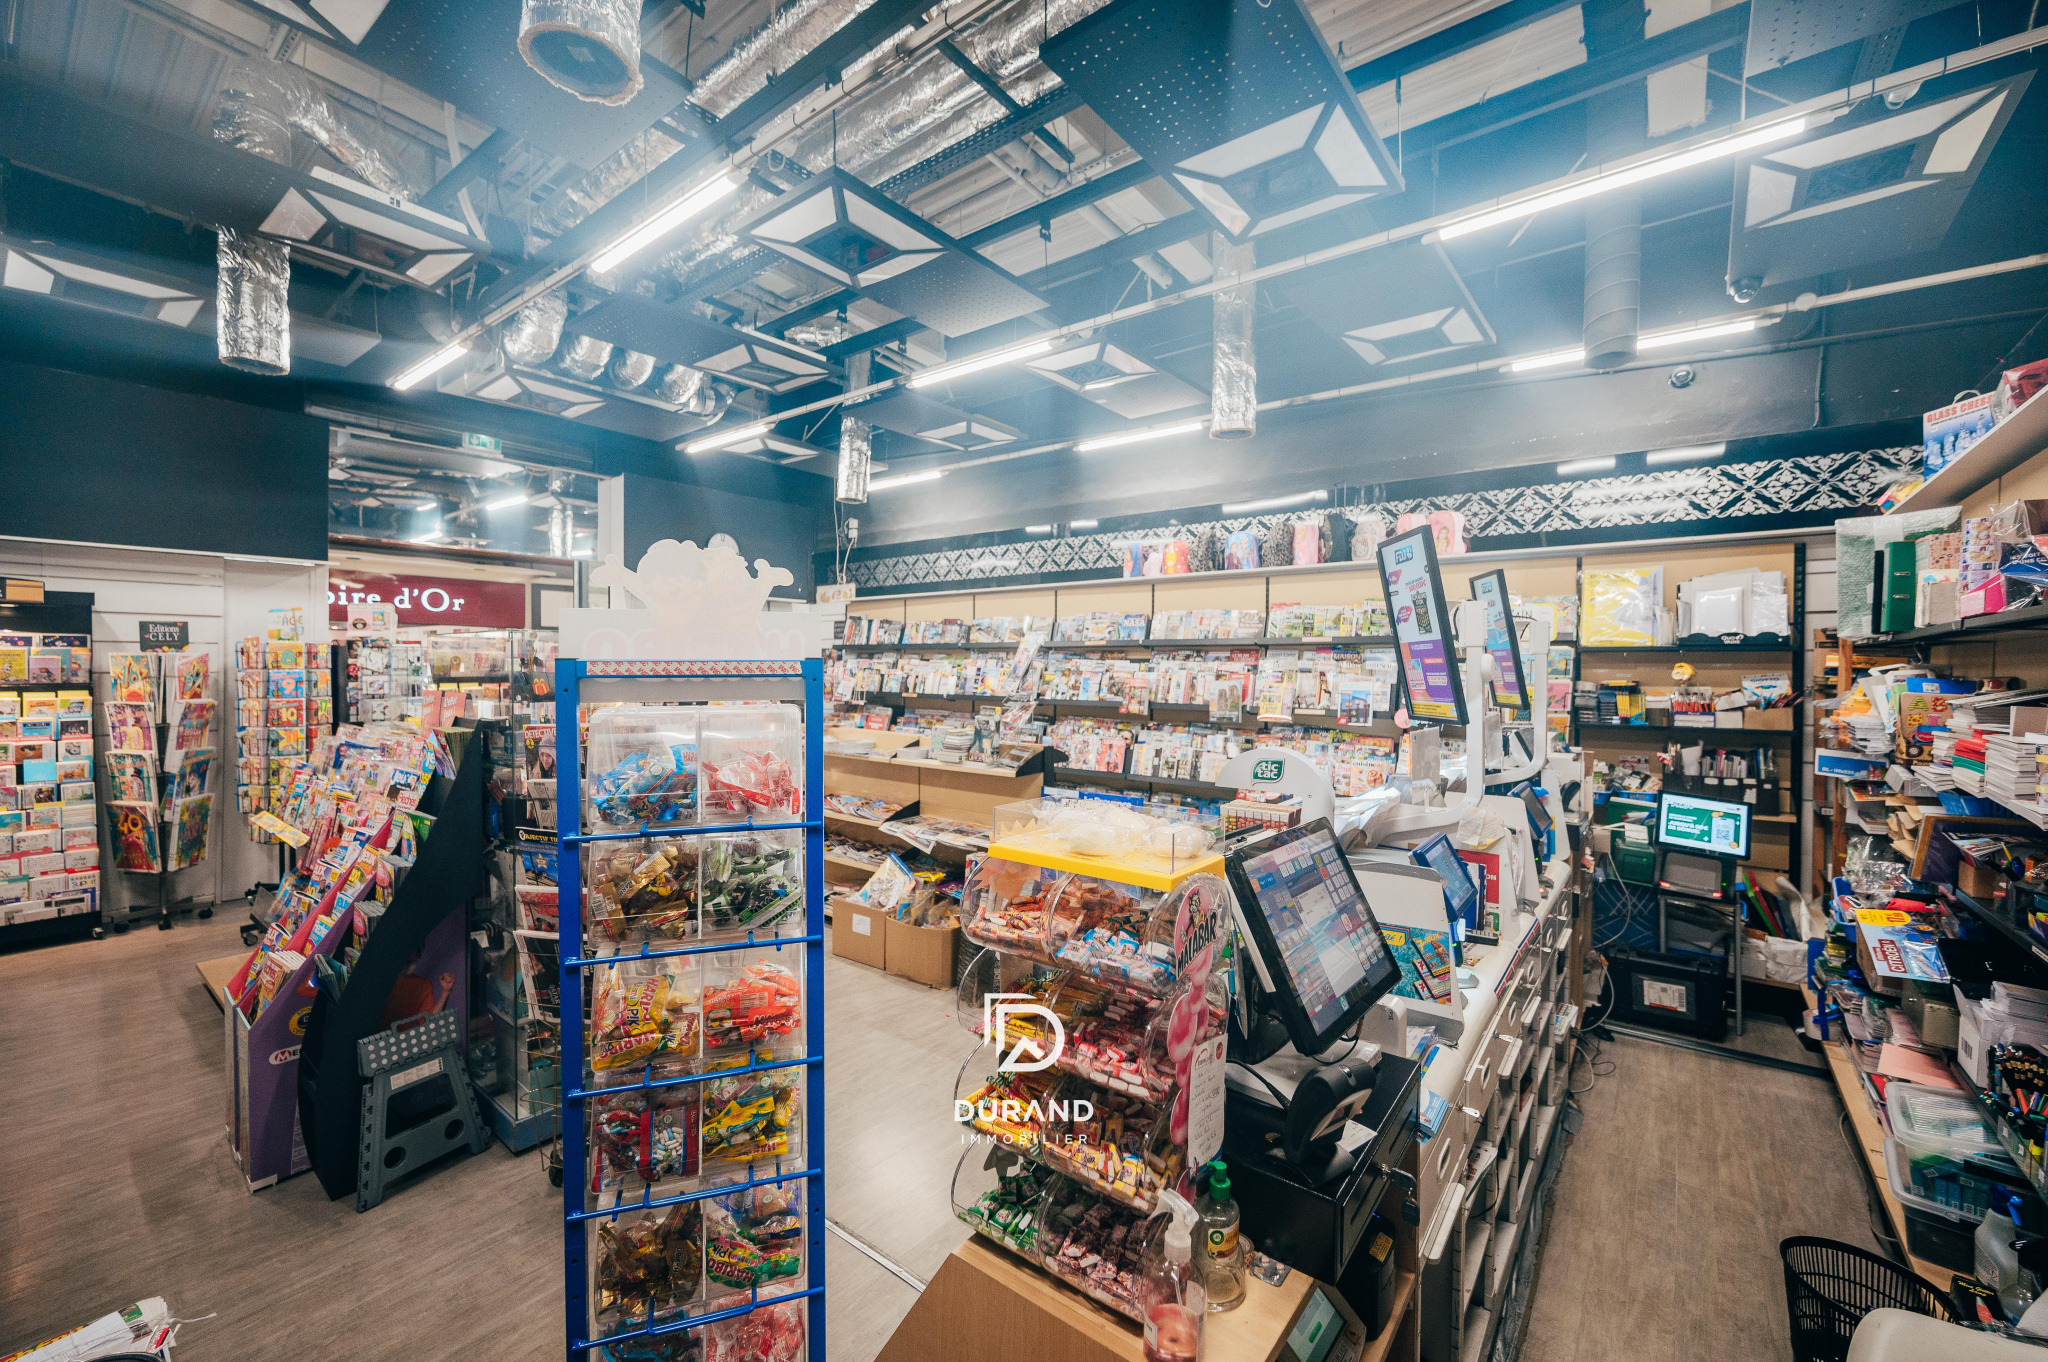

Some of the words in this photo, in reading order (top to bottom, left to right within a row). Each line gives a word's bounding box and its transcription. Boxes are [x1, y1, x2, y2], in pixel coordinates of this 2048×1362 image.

[1927, 406, 1957, 423] GLASS
[1960, 394, 1994, 412] CHESS
[393, 587, 465, 612] d'Or
[149, 624, 180, 633] Editions
[1123, 618, 1146, 627] NASA
[149, 632, 180, 641] CELY
[280, 649, 297, 666] 8
[282, 679, 296, 695] 9
[1908, 696, 1929, 711] A
[1931, 697, 1948, 712] B
[281, 706, 298, 722] 10
[1907, 712, 1924, 728] H
[1257, 768, 1279, 779] tac
[1261, 762, 1280, 770] tic
[1177, 910, 1218, 980] MALABAR
[1882, 944, 1906, 973] CITROËN
[706, 1257, 756, 1284] HARIBO
[1957, 1280, 1974, 1289] Mini
